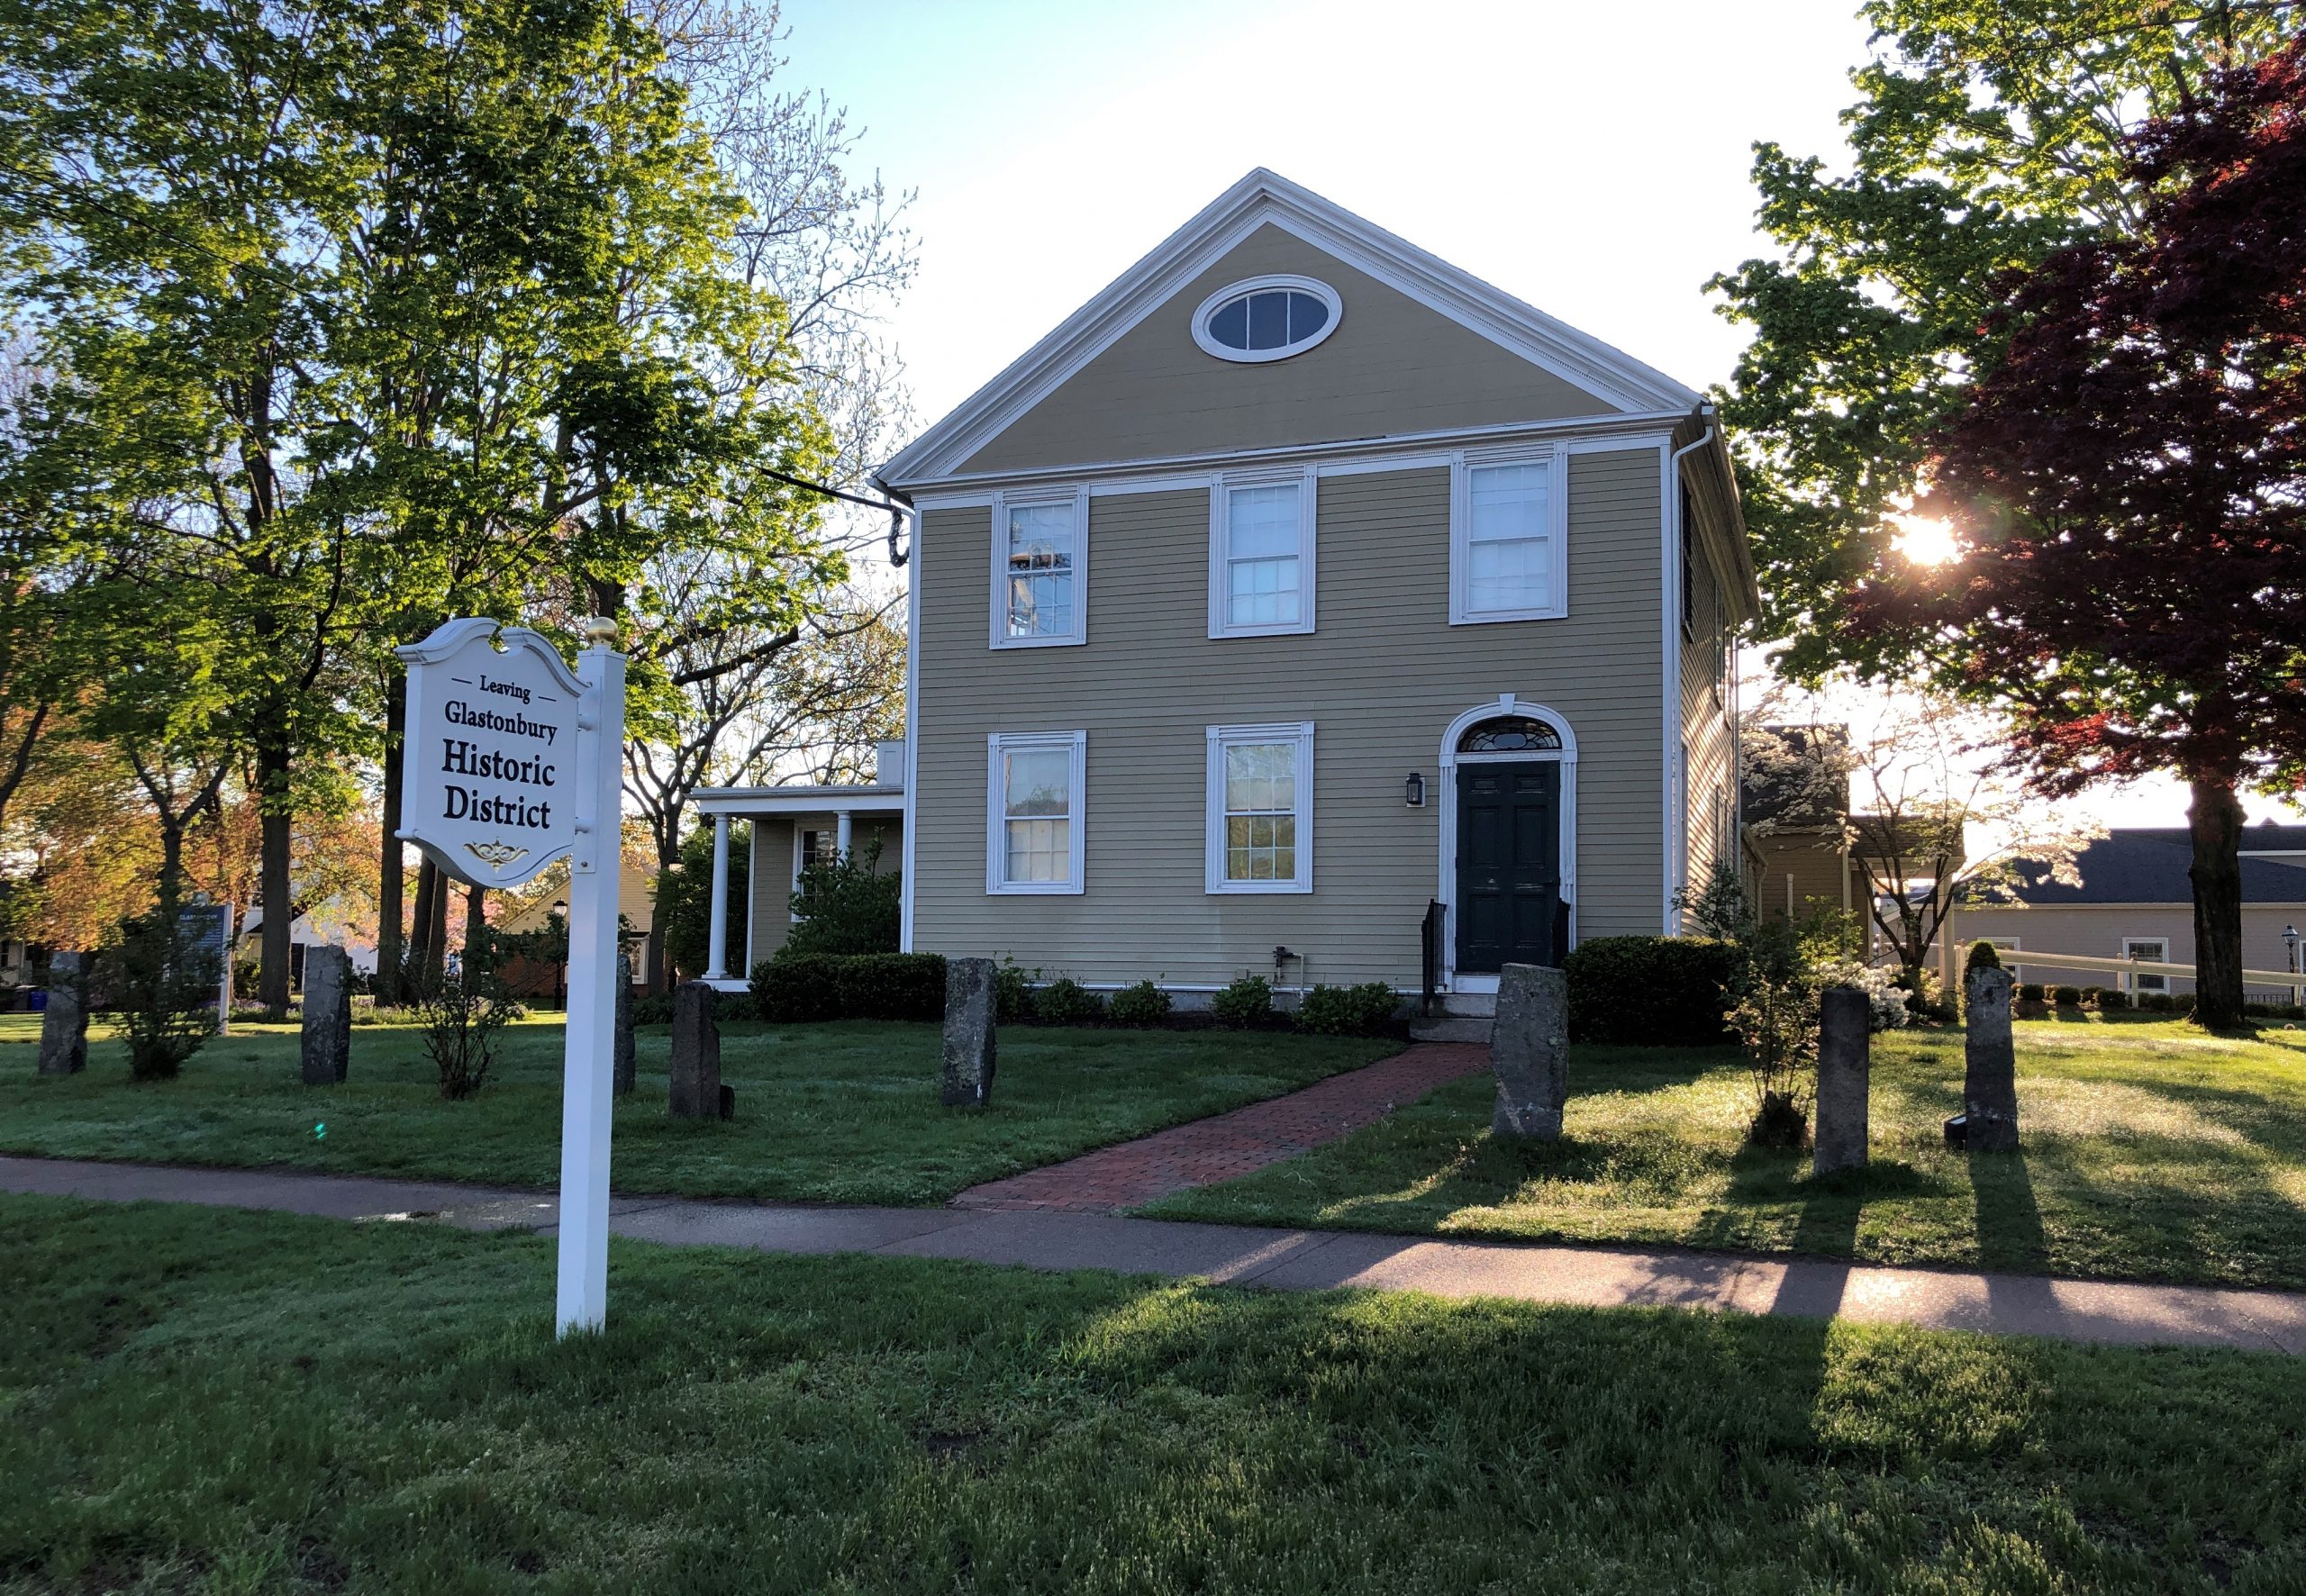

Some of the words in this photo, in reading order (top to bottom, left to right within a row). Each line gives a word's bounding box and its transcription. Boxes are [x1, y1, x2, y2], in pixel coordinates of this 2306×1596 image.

[479, 675, 531, 704] Leaving
[444, 700, 558, 746] Glastonbury
[441, 738, 556, 787] Historic
[443, 784, 551, 829] District
